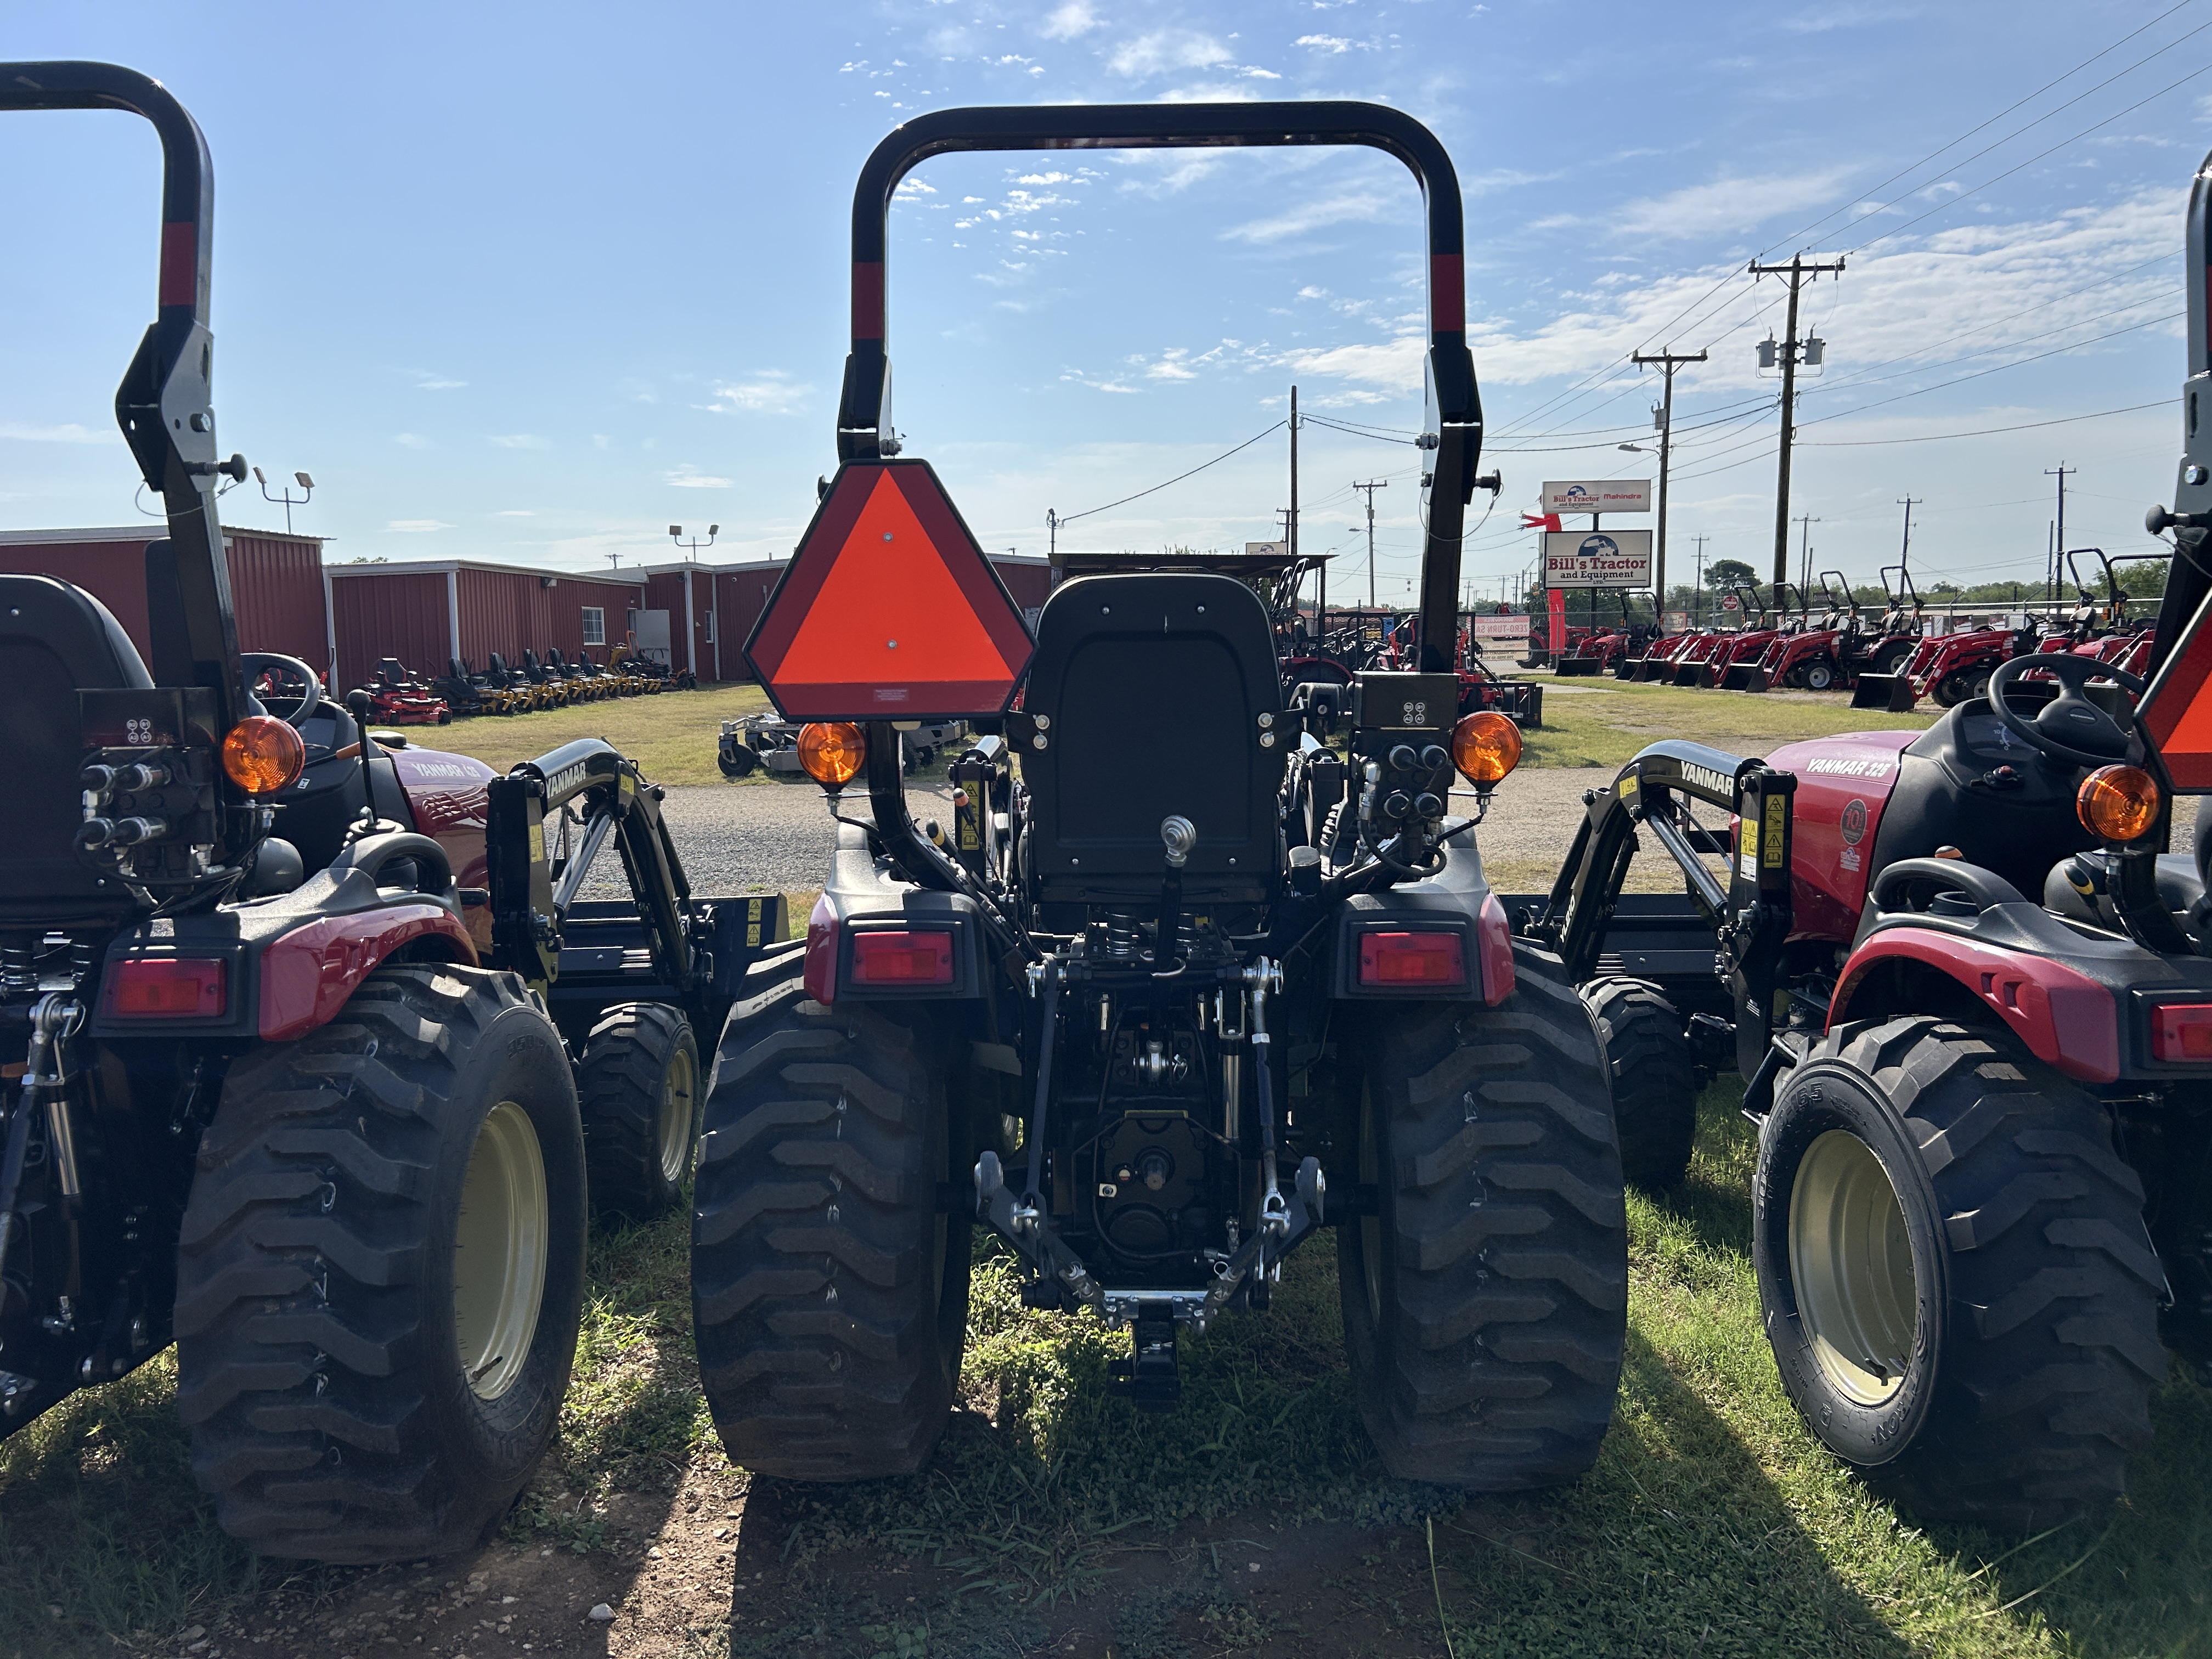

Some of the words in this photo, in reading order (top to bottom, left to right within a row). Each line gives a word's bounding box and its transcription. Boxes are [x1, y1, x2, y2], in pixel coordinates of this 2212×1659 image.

[1548, 558, 1587, 570] Bill's
[1590, 557, 1646, 569] Tractor
[1581, 570, 1634, 580] Equipment
[411, 763, 465, 777] YANMAR
[1680, 760, 1734, 797] YANMAR
[1806, 758, 1869, 775] YANMAR
[1864, 762, 1892, 778] 325
[546, 761, 586, 799] YANMAR
[1846, 808, 1860, 830] 10
[1560, 894, 1576, 943] YL210
